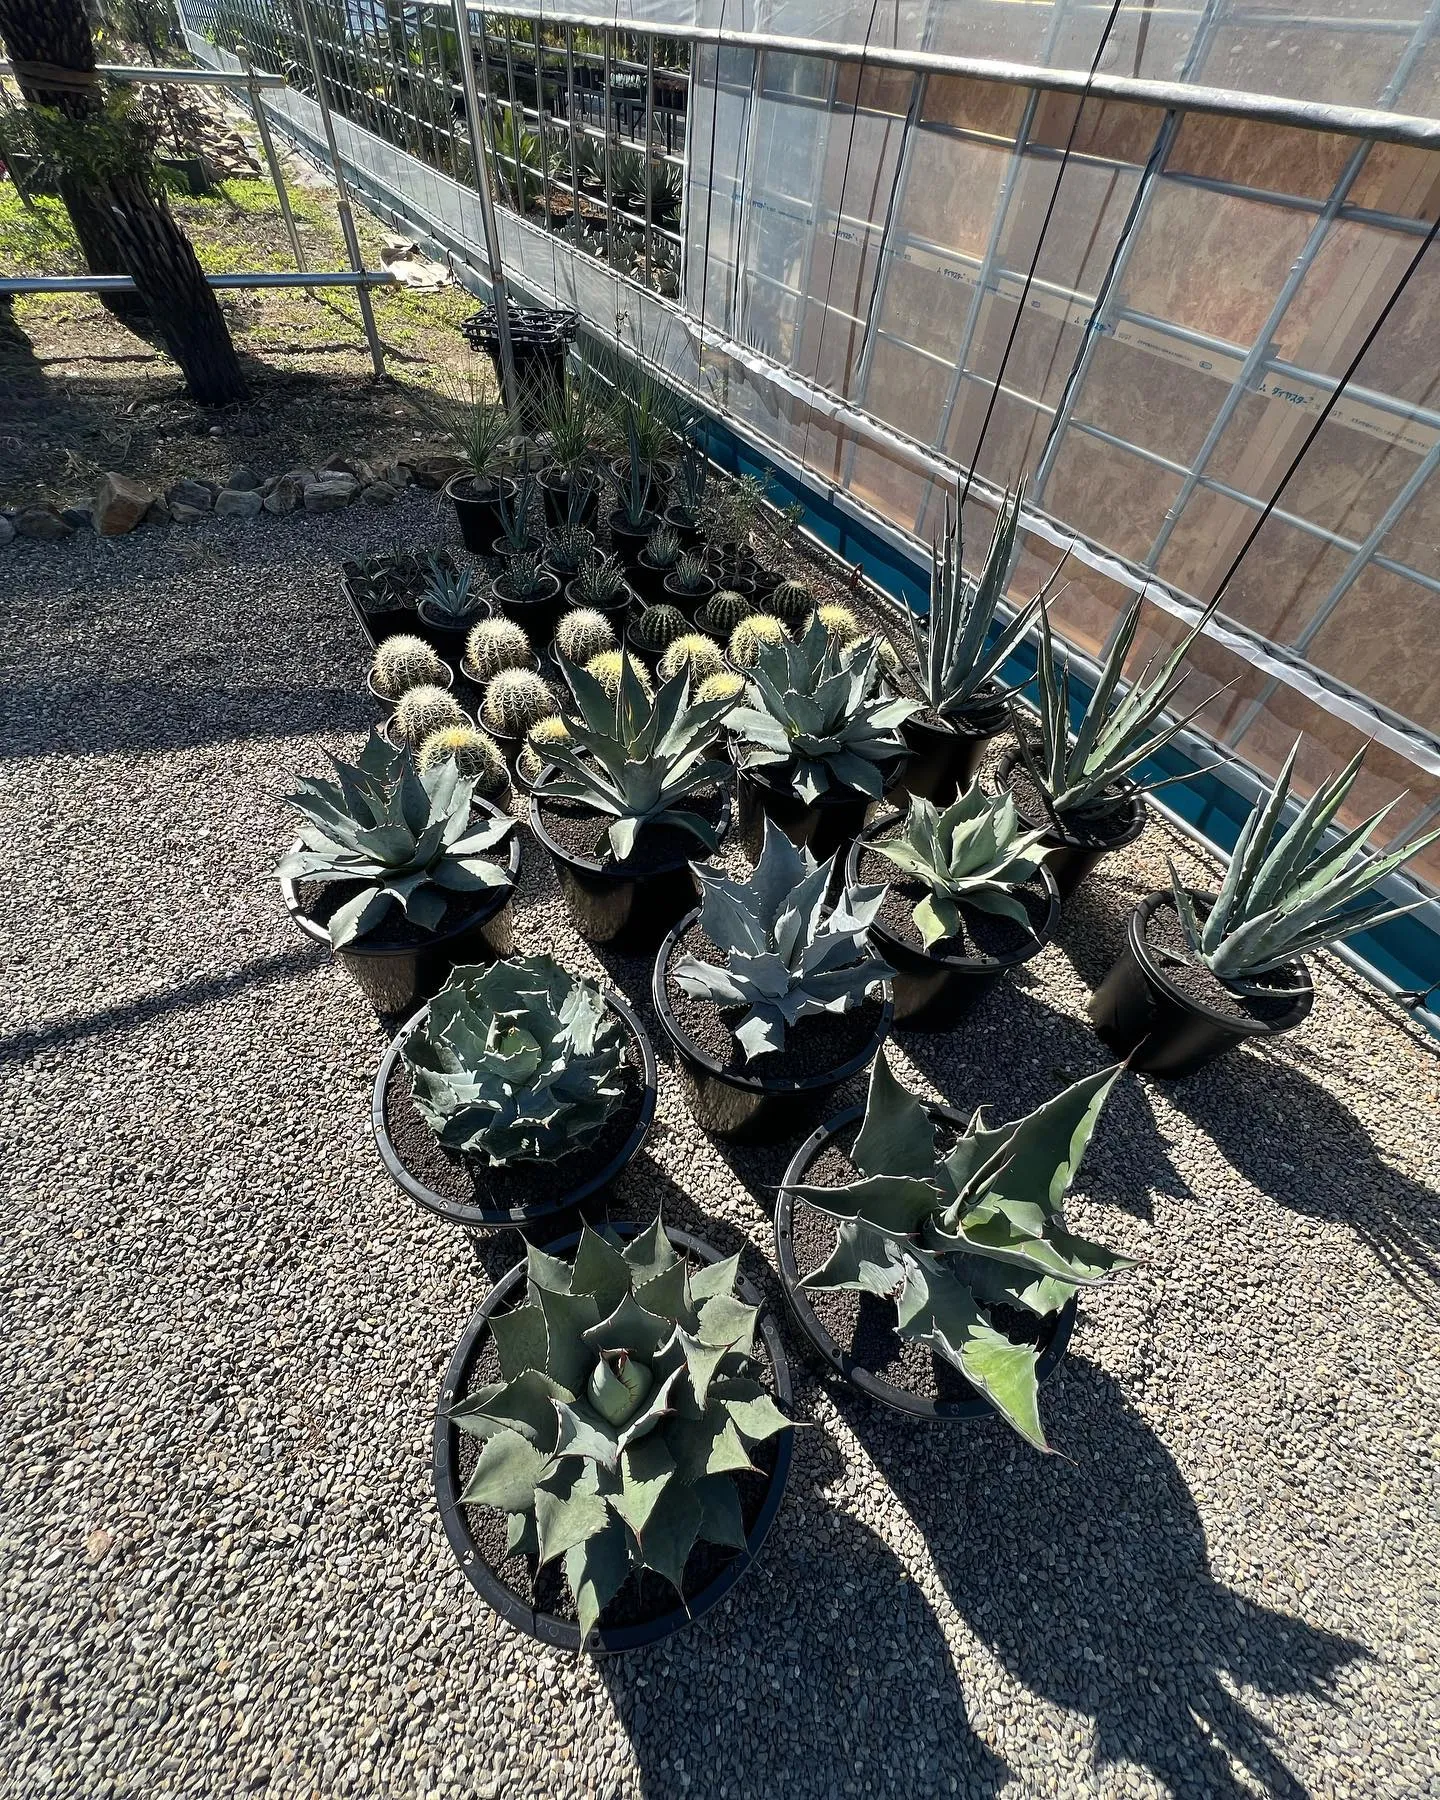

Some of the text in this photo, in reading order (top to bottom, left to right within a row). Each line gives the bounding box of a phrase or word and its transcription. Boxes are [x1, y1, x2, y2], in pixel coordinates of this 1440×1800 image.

[1271, 386, 1308, 404] ダイヤスター
